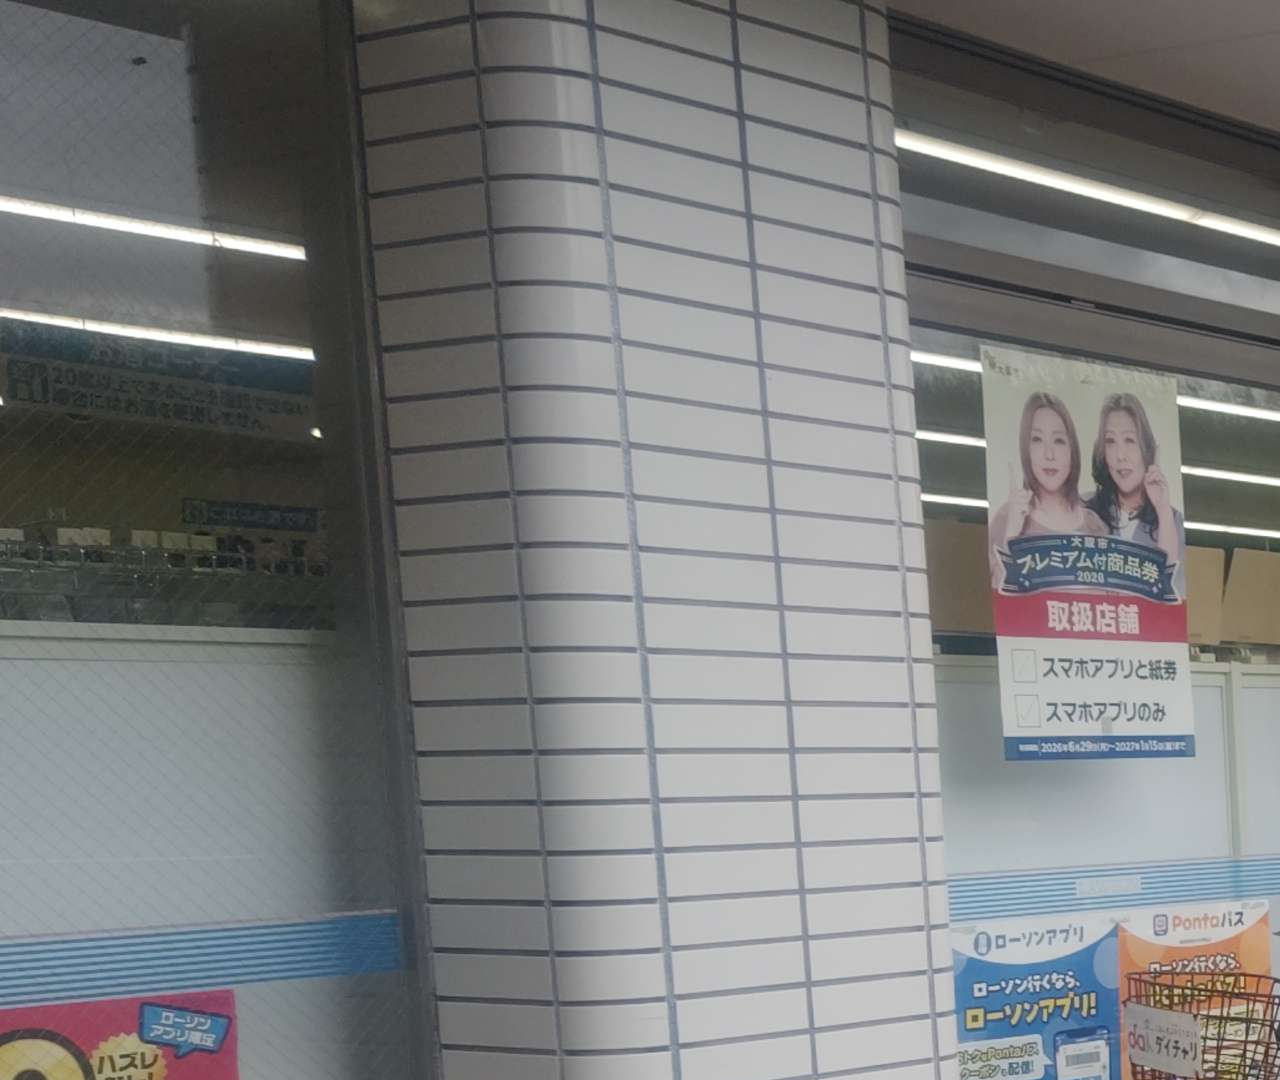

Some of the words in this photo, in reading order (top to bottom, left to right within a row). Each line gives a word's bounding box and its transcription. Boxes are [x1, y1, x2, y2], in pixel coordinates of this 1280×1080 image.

[1016, 549, 1160, 582] プレミアム付商品券
[1046, 601, 1141, 635] 取扱店舗
[1042, 657, 1178, 682] スマホアプリと紙券
[1045, 701, 1167, 724] スマホアプリのみ
[1171, 911, 1245, 932] Pontaパス
[995, 924, 1084, 949] ローソンアプリ
[973, 971, 1081, 998] ローソン行くなら、
[160, 1011, 212, 1031] ローソン
[964, 991, 1098, 1030] ローソンアプリ!
[97, 1051, 159, 1075] ハズレ
